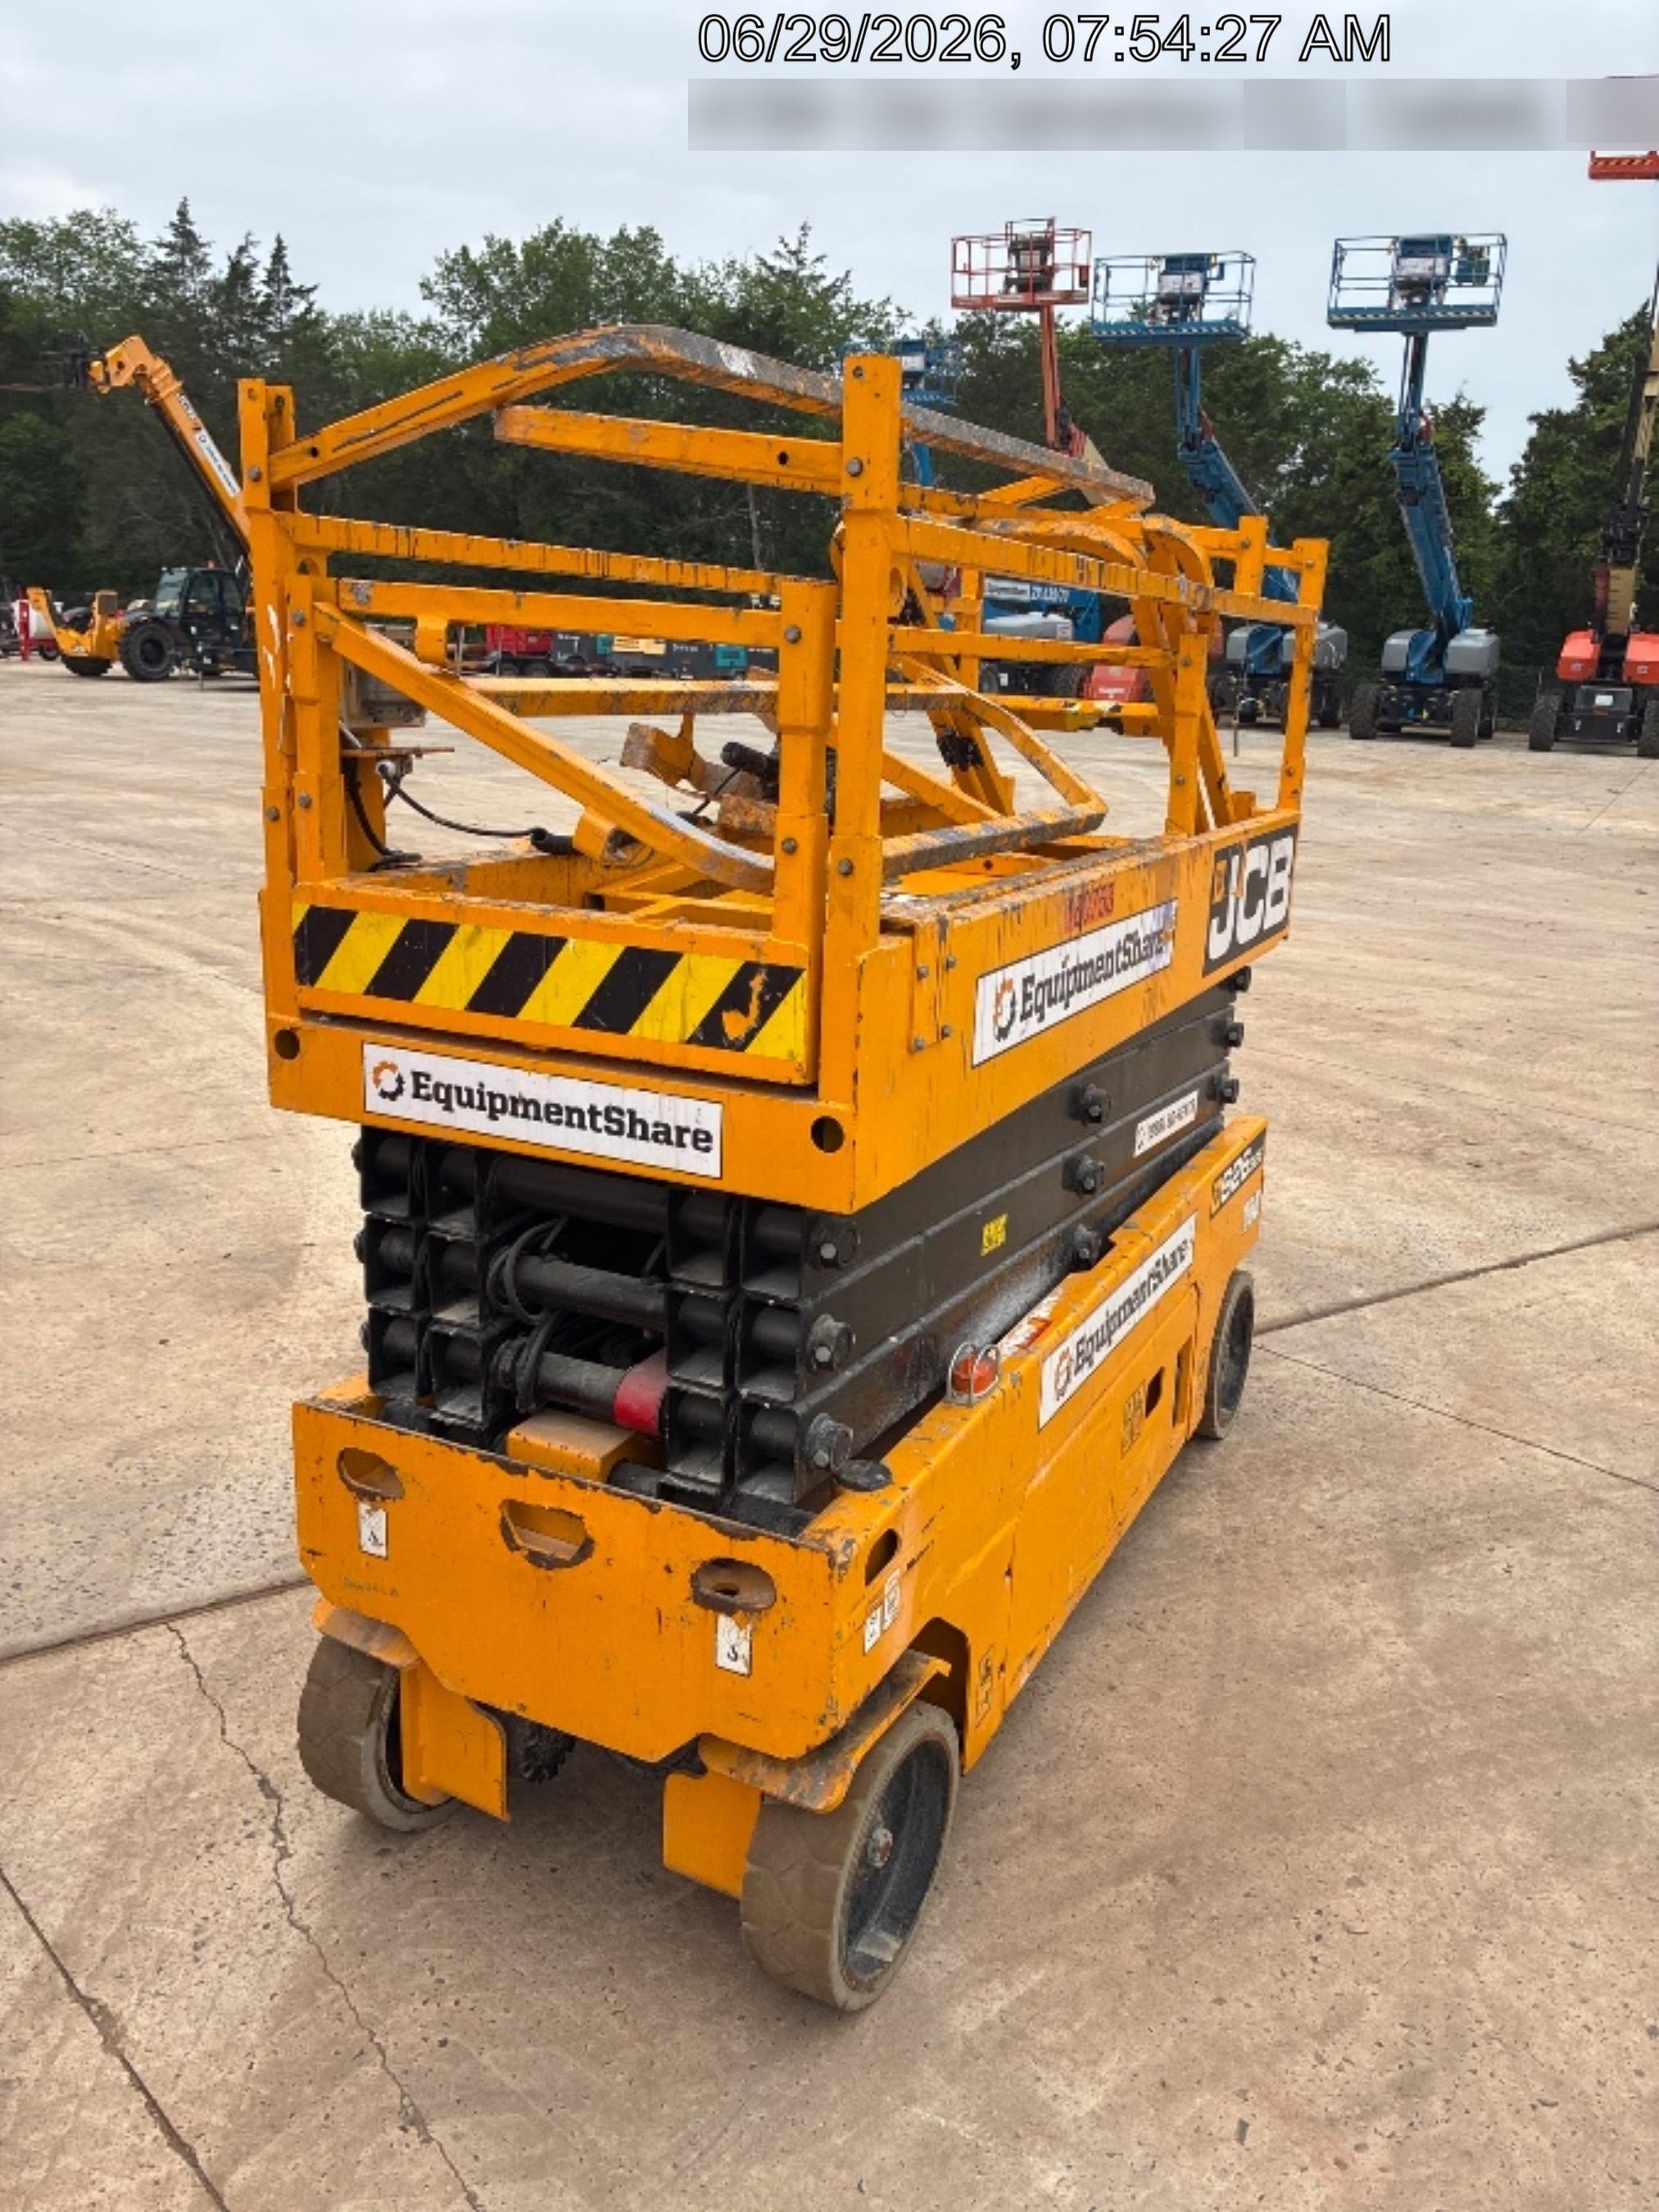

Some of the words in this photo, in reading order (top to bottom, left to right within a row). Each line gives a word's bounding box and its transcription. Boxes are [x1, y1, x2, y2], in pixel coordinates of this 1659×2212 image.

[1208, 836, 1294, 960] JCB
[411, 1070, 714, 1154] EquipmentShare
[1072, 1239, 1189, 1371] EquipmentShare
